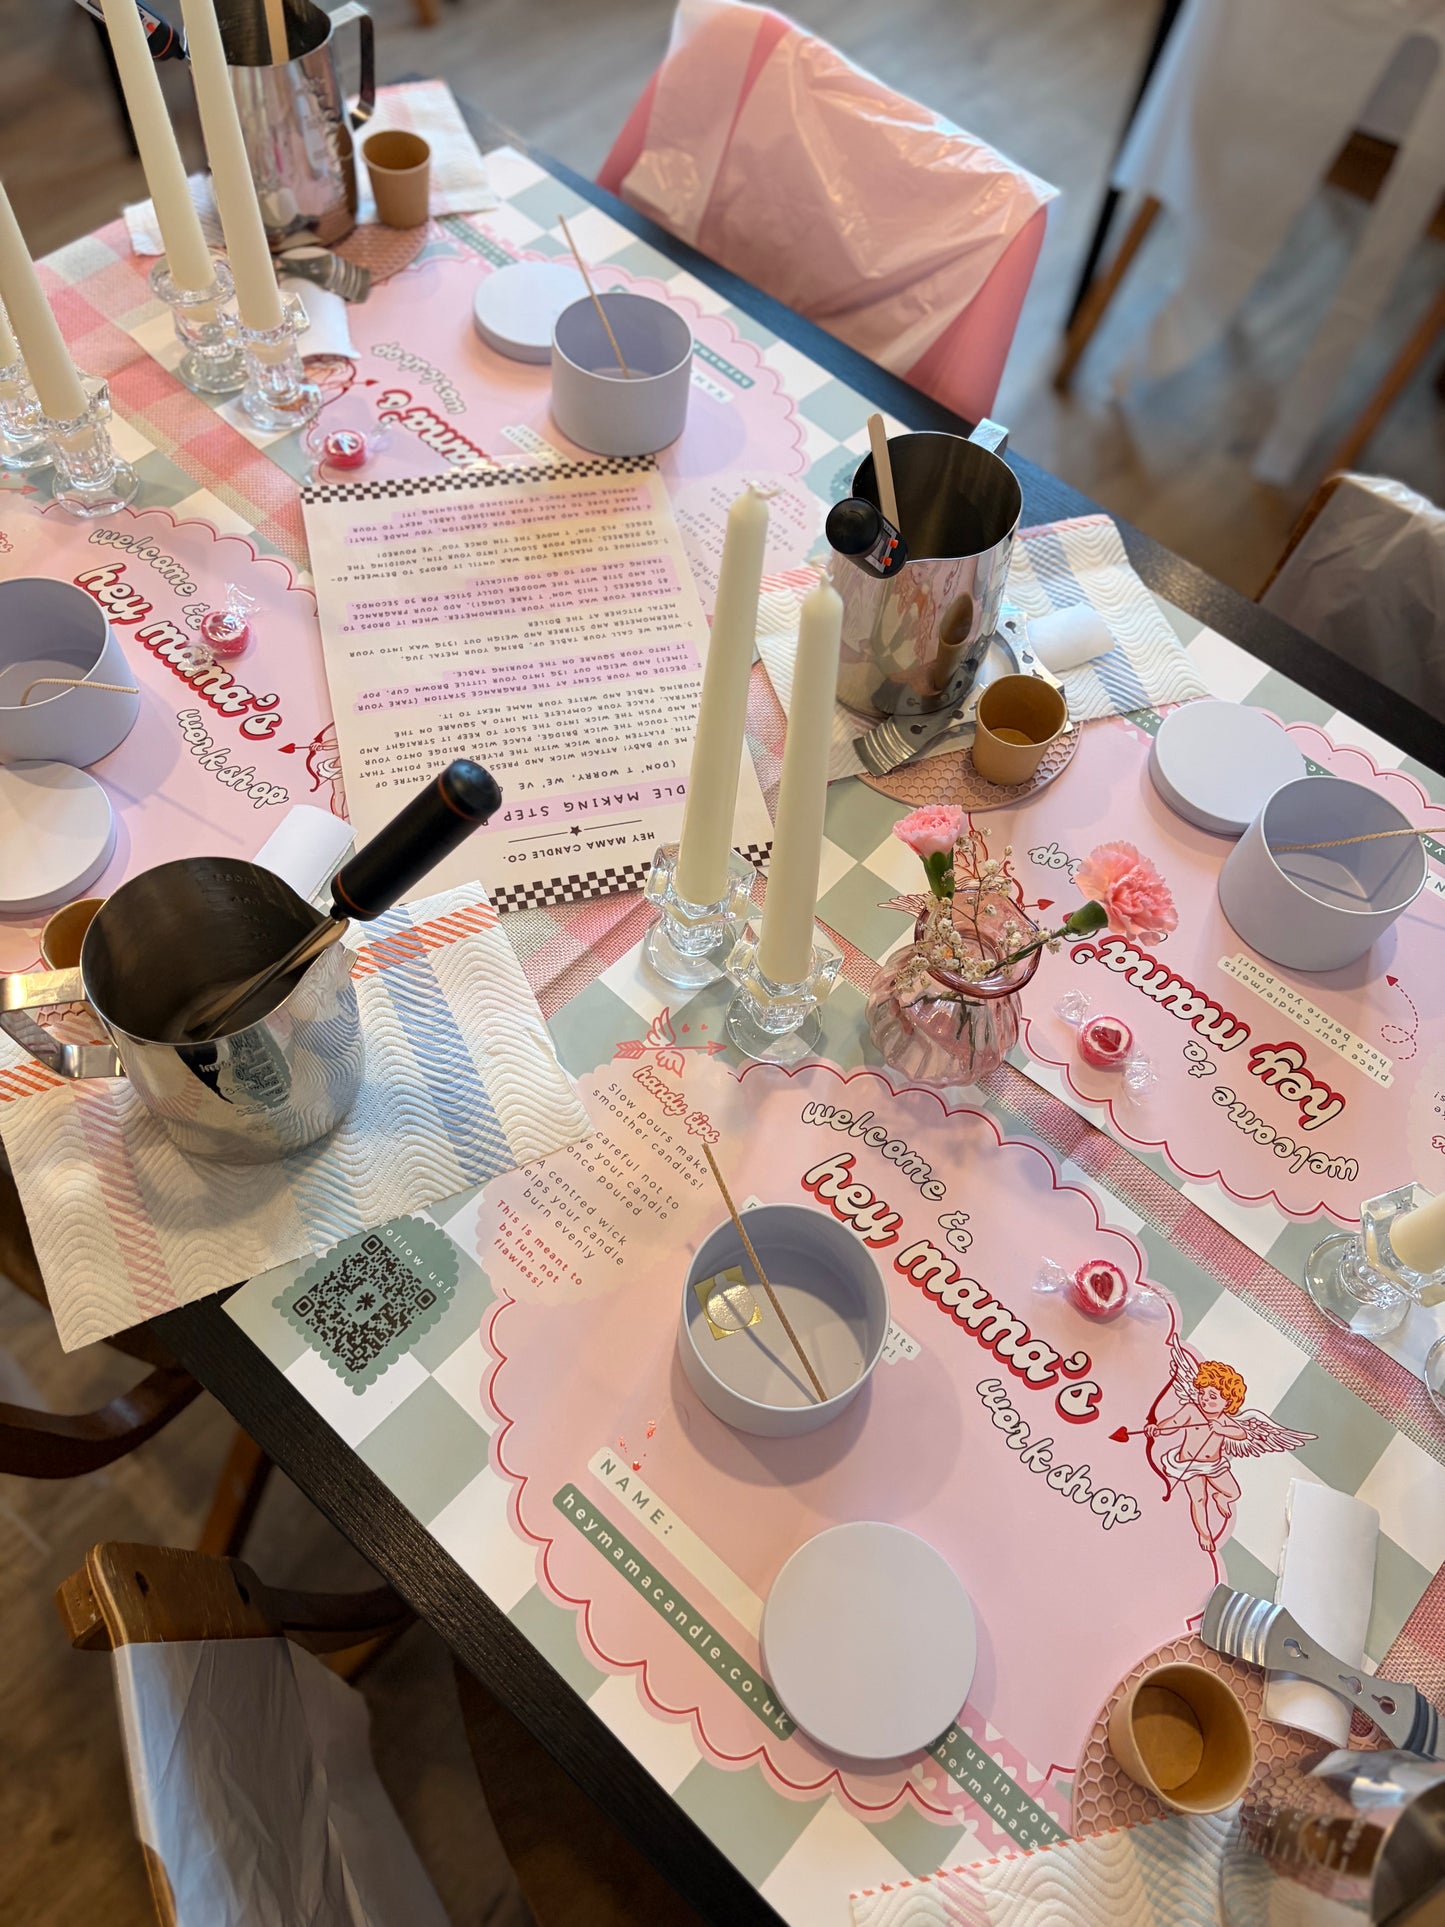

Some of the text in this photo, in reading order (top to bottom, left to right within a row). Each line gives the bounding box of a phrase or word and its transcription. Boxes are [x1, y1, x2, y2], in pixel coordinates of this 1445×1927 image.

[376, 388, 502, 471] ama's
[88, 528, 198, 598] welcome
[73, 562, 154, 626] hey
[613, 613, 678, 626] THERMOMETER
[547, 625, 585, 635] STIRRER
[349, 649, 374, 657] YOUR
[653, 664, 686, 674] DECIDE
[572, 675, 601, 684] SCENT
[606, 672, 630, 680] YOUR
[471, 685, 526, 696] FRAGRANCE
[388, 697, 417, 707] (TAKE
[424, 692, 465, 702] STATION
[357, 702, 383, 711] YOUR
[638, 707, 662, 715] PUSH
[531, 722, 550, 730] THE
[555, 718, 579, 726] INTO
[637, 718, 668, 726] TOUCH
[503, 725, 526, 733] SLOT
[625, 729, 664, 739] FLATTEN
[457, 731, 480, 740] KEEP
[502, 736, 531, 745] PLACE
[595, 735, 619, 743] YOUR
[673, 736, 687, 744] ME
[386, 738, 434, 750] STRAIGHT
[471, 741, 497, 749] WICK
[533, 744, 559, 752] WITH
[564, 739, 590, 747] WICK
[623, 741, 652, 751] BABY!
[359, 746, 379, 754] AND
[396, 751, 422, 760] ONTO
[428, 744, 465, 756] BRIDGE
[509, 748, 528, 756] THE
[580, 747, 617, 756] ATTACH
[176, 708, 290, 810] workshop
[364, 756, 390, 765] YOUR
[524, 757, 543, 765] AND
[549, 753, 575, 761] WICK
[359, 760, 445, 778] THE POINT THAT
[489, 760, 518, 770] PRESS
[375, 774, 431, 788] CENTRE OF
[503, 791, 638, 821] MAKING STEP
[503, 831, 654, 862] HEY MAMA CANDLE CO.
[1237, 957, 1386, 1067] here before you pour!
[1062, 911, 1347, 1131] hey mama'
[1224, 961, 1388, 1081] place your candle/melts
[632, 1065, 719, 1145] handy tips
[1182, 1039, 1360, 1182] welcome to
[608, 1083, 707, 1174] Slow pours make
[592, 1089, 703, 1189] smoother candles!
[595, 1131, 679, 1209] careful not to
[566, 1145, 642, 1215] once poured
[800, 1100, 974, 1255] welcome to
[594, 1152, 623, 1177] your
[626, 1181, 667, 1219] candle
[536, 1159, 626, 1245] A centred wick
[522, 1187, 594, 1258] burn evenly
[549, 1195, 580, 1221] your
[583, 1225, 623, 1265] candle
[497, 1199, 582, 1285] This is meant to
[498, 1222, 558, 1283] be fun, not
[494, 1238, 543, 1287] flawless!
[428, 1271, 451, 1293] us!
[800, 1151, 1104, 1425] hey mama's
[975, 1377, 1142, 1531] workshop
[600, 1459, 672, 1533] NAME:
[563, 1496, 789, 1732] heymamacandle.co.uk
[966, 1748, 985, 1769] us
[992, 1772, 1010, 1795] in
[937, 1745, 1037, 1849] heymamaca
